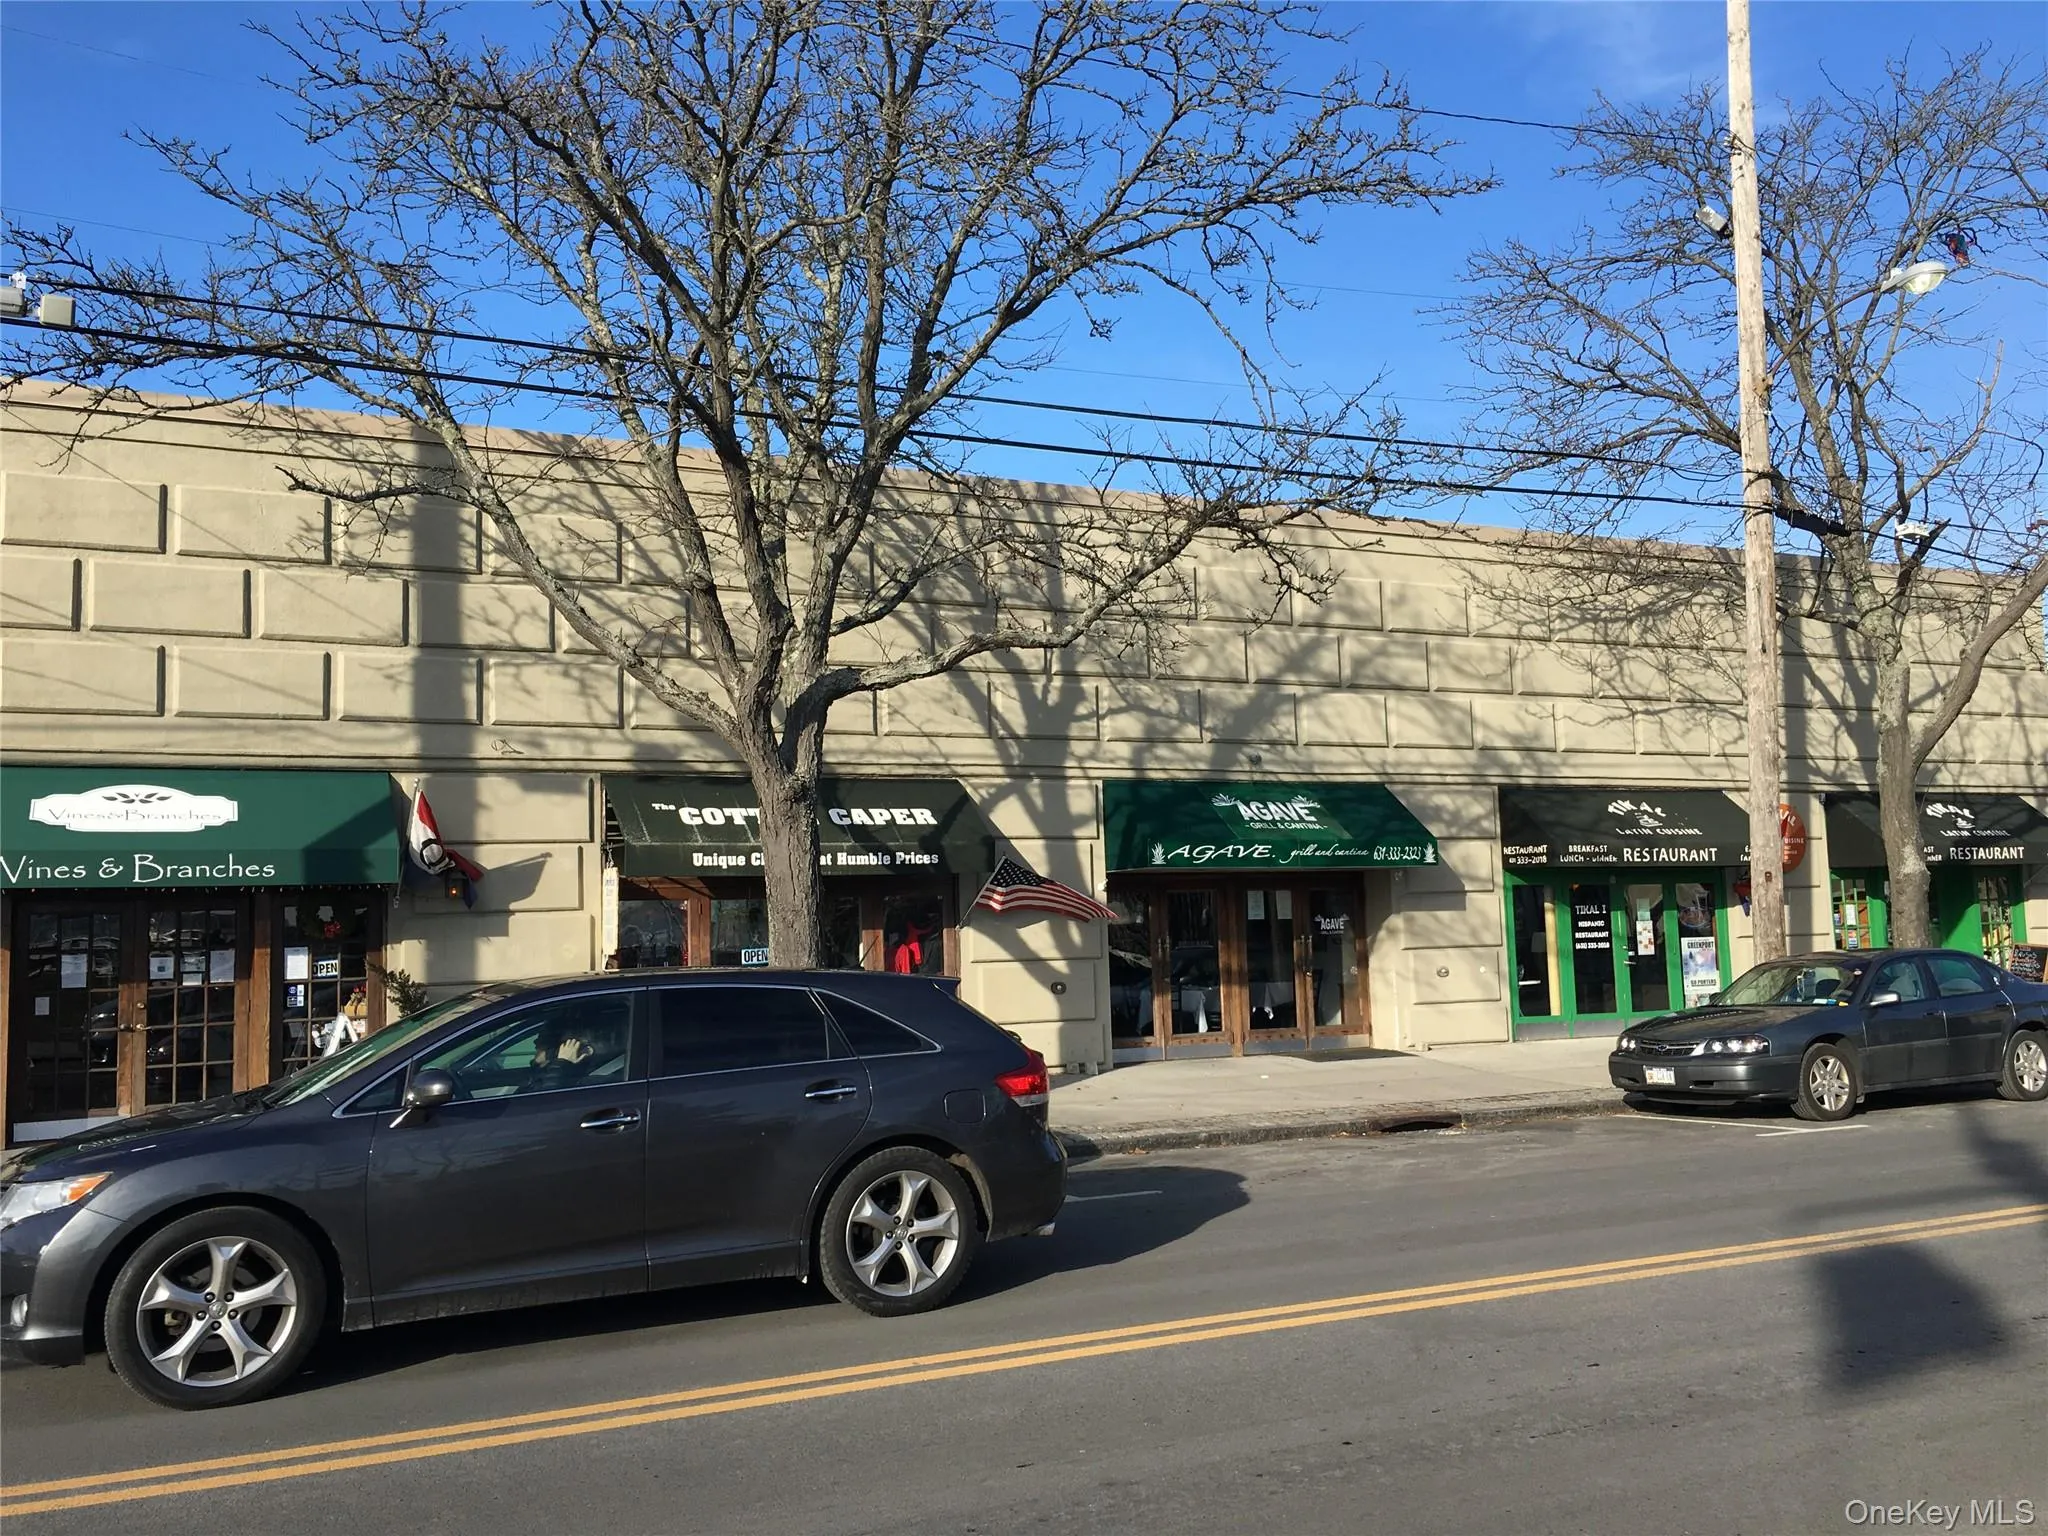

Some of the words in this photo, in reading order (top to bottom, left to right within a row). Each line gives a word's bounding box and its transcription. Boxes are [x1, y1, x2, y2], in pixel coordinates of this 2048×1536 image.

[652, 803, 676, 811] The
[828, 808, 937, 825] CAPER
[1238, 800, 1317, 821] AGAVE
[1503, 845, 1548, 855] RESTAURANT
[1568, 844, 1608, 853] BREAKFAST
[1623, 847, 1718, 863] RESTAURANT
[1949, 846, 2025, 860] RESTAURANT
[692, 852, 747, 869] Unique
[836, 852, 891, 866] Humble
[895, 851, 940, 865] Prices
[1559, 854, 1584, 863] LUNCH
[0, 855, 87, 884] Vines
[98, 857, 124, 879] &
[132, 853, 276, 883] Branches
[1320, 918, 1345, 930] AGAVE
[744, 950, 769, 963] OPEN
